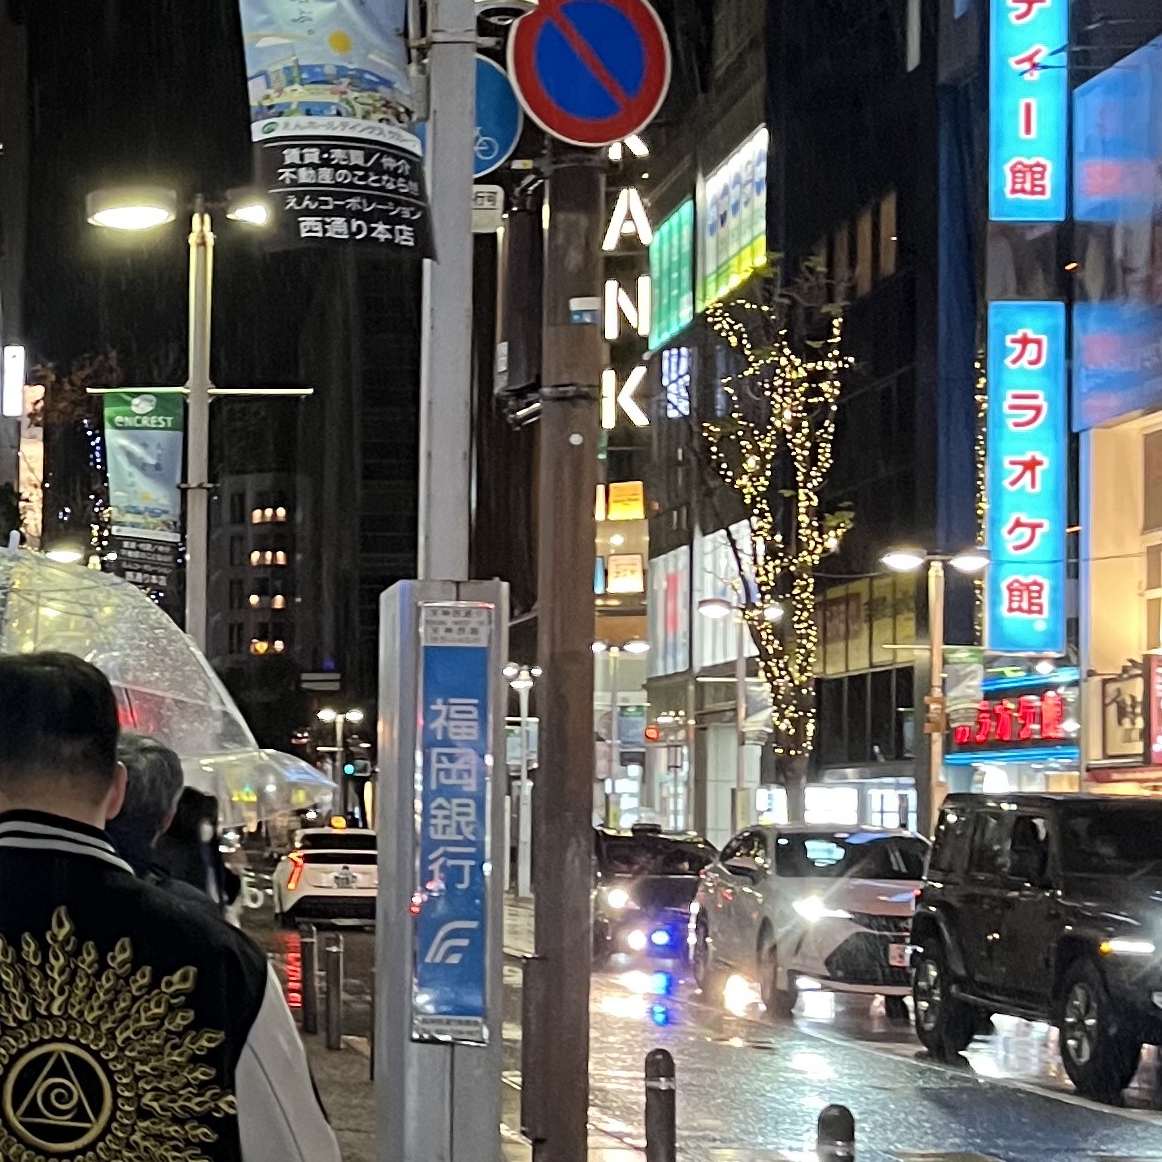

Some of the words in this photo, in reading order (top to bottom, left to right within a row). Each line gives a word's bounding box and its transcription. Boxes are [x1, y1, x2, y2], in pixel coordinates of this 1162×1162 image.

[297, 217, 415, 246] 西通り本店
[1003, 329, 1049, 618] カラオケ館
[428, 697, 479, 889] 福岡銀行
